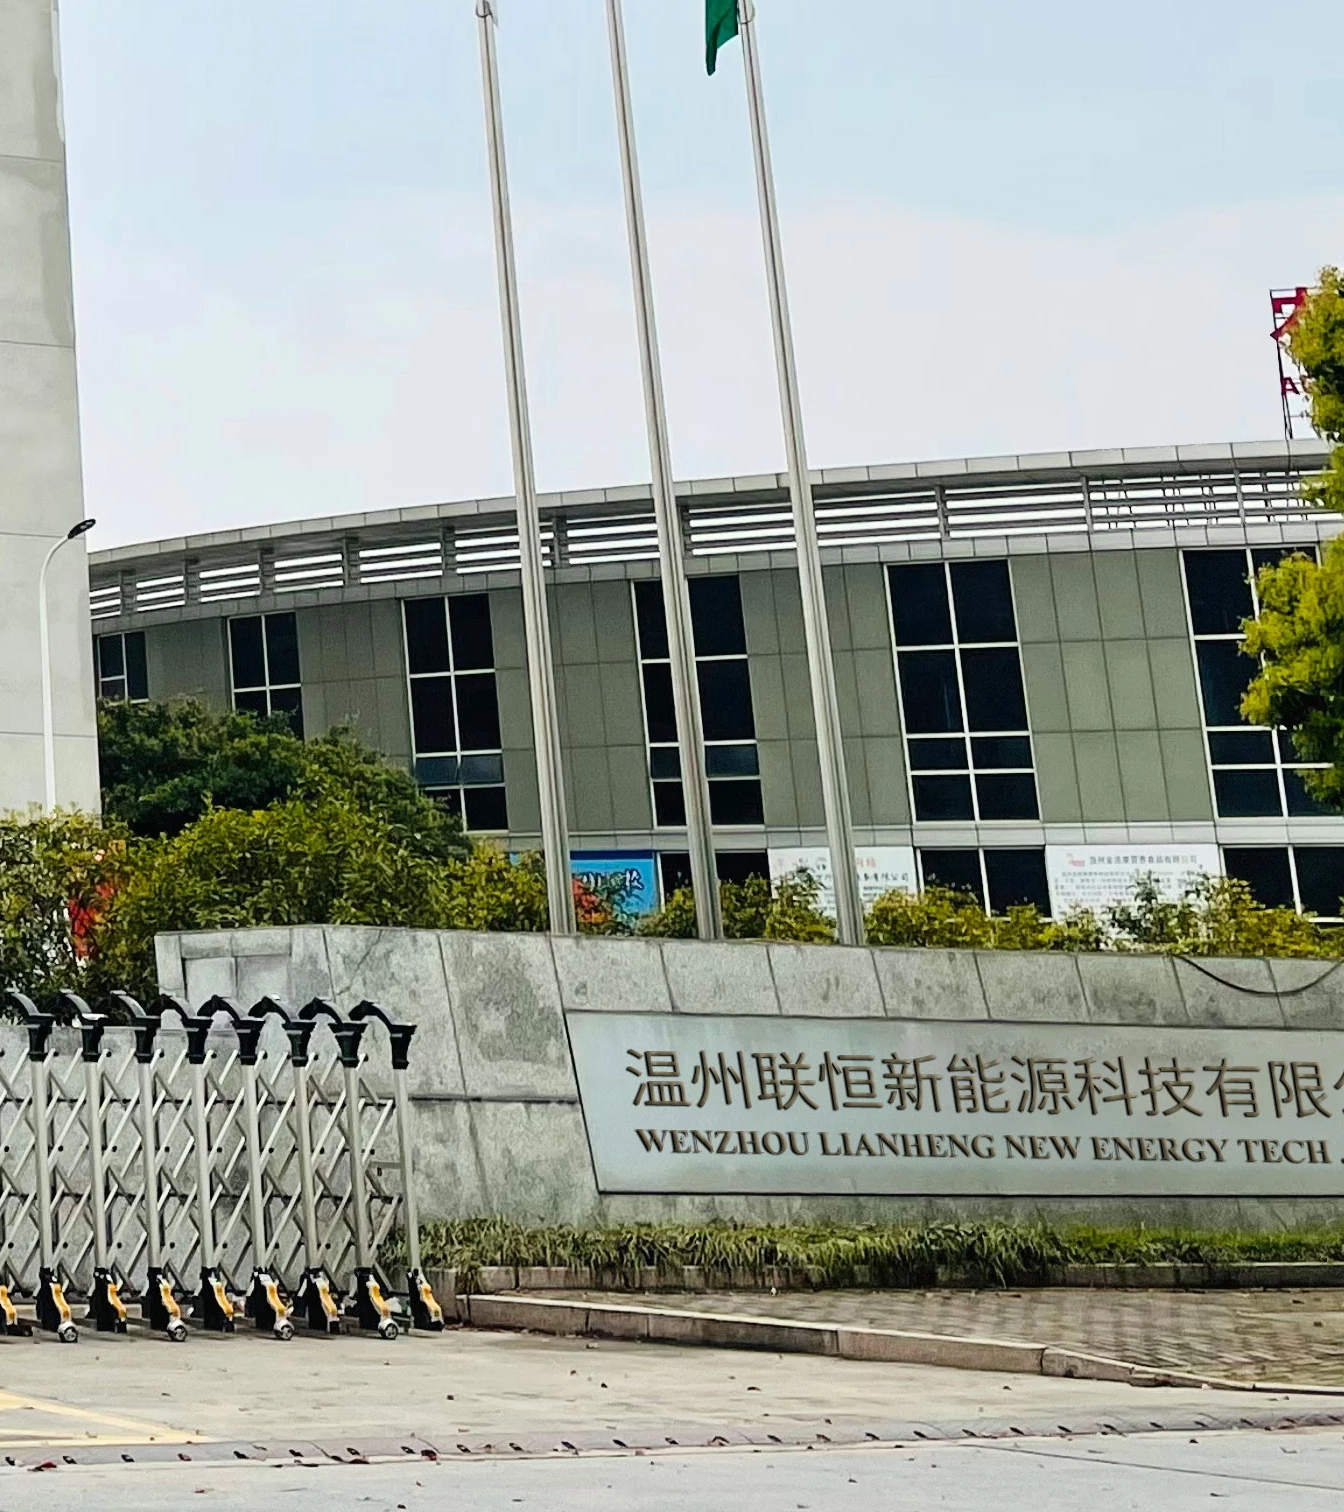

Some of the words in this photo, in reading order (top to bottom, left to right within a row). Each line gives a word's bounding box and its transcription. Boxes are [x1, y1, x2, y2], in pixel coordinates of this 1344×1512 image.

[635, 1129, 810, 1156] WENZHOU
[818, 1132, 996, 1159] LIANHENG
[1005, 1135, 1081, 1160] NEW
[1092, 1137, 1229, 1163] ENERGY
[1237, 1139, 1332, 1165] TECH
